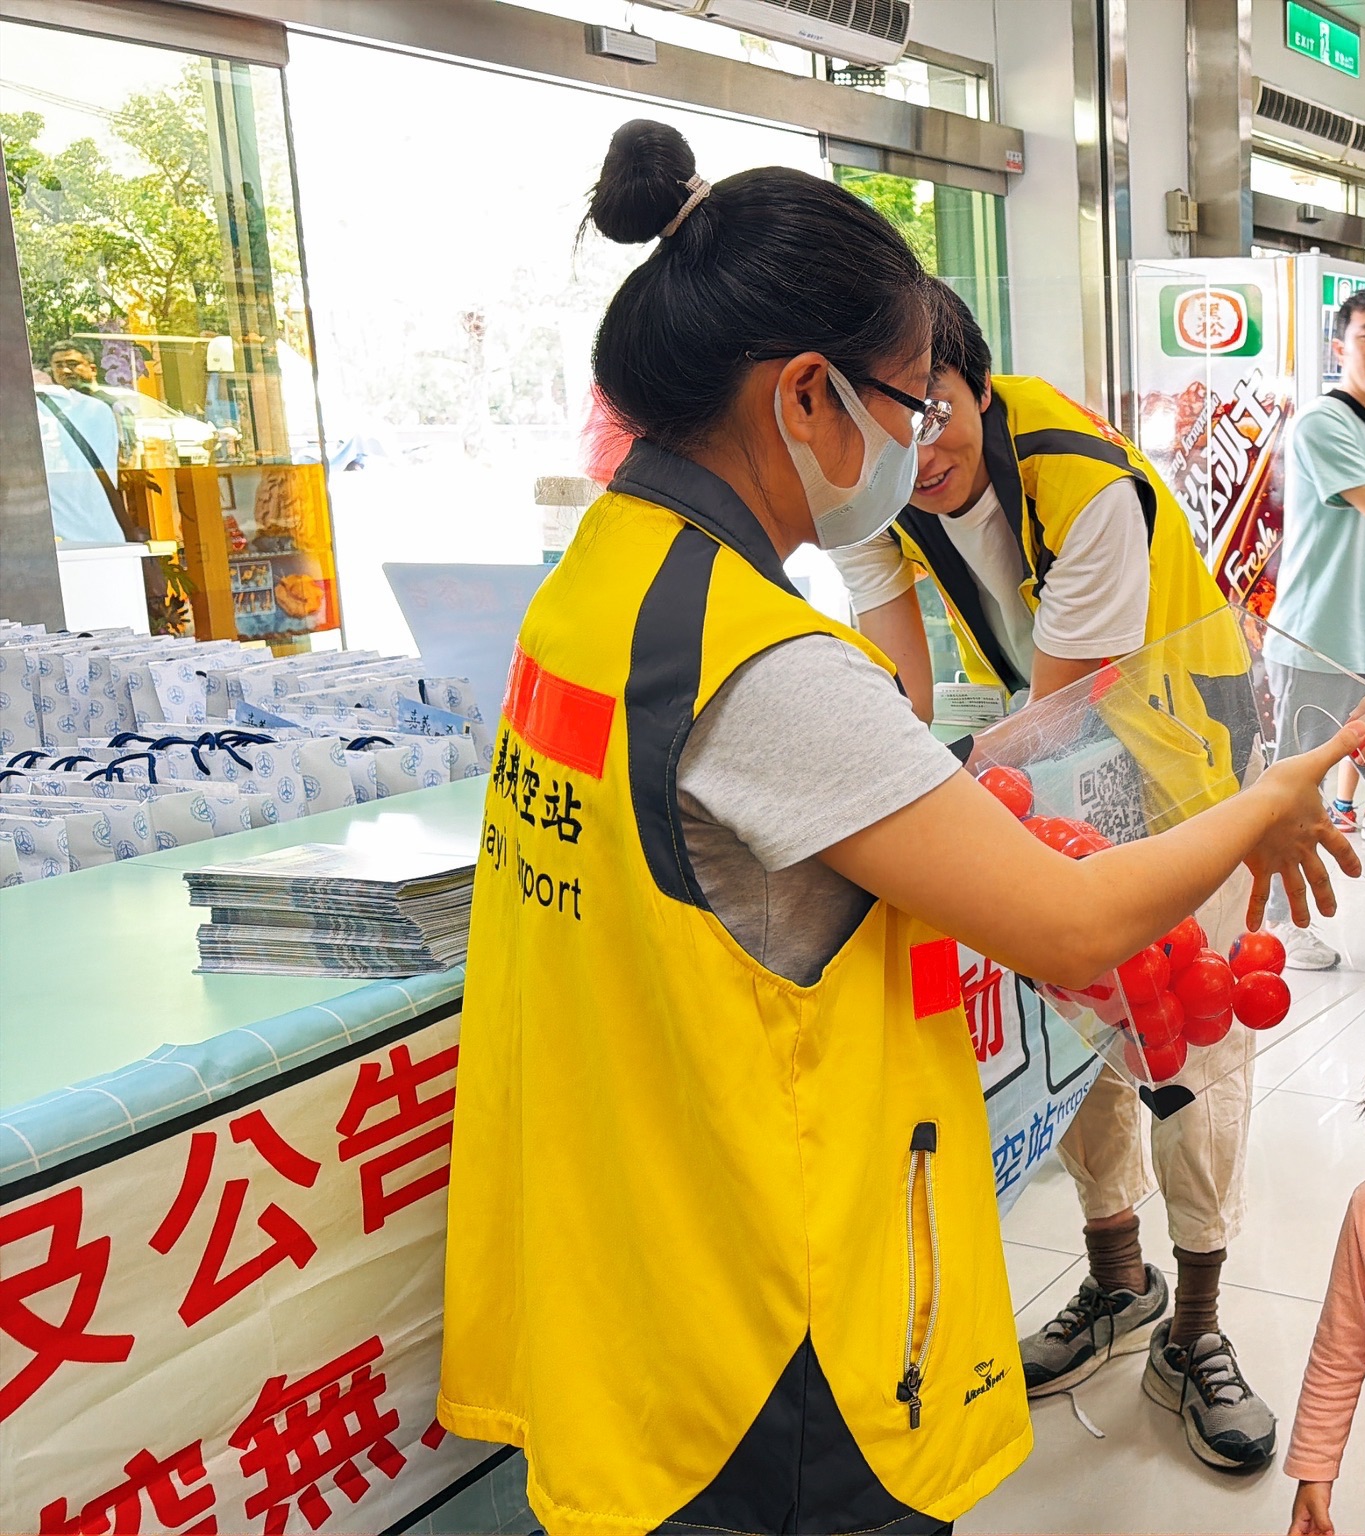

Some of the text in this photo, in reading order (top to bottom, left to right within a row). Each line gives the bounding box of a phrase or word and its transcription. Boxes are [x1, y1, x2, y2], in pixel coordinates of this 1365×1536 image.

[1294, 31, 1315, 52] EXIT
[1224, 518, 1278, 600] Fresh
[39, 1334, 448, 1536] 空無
